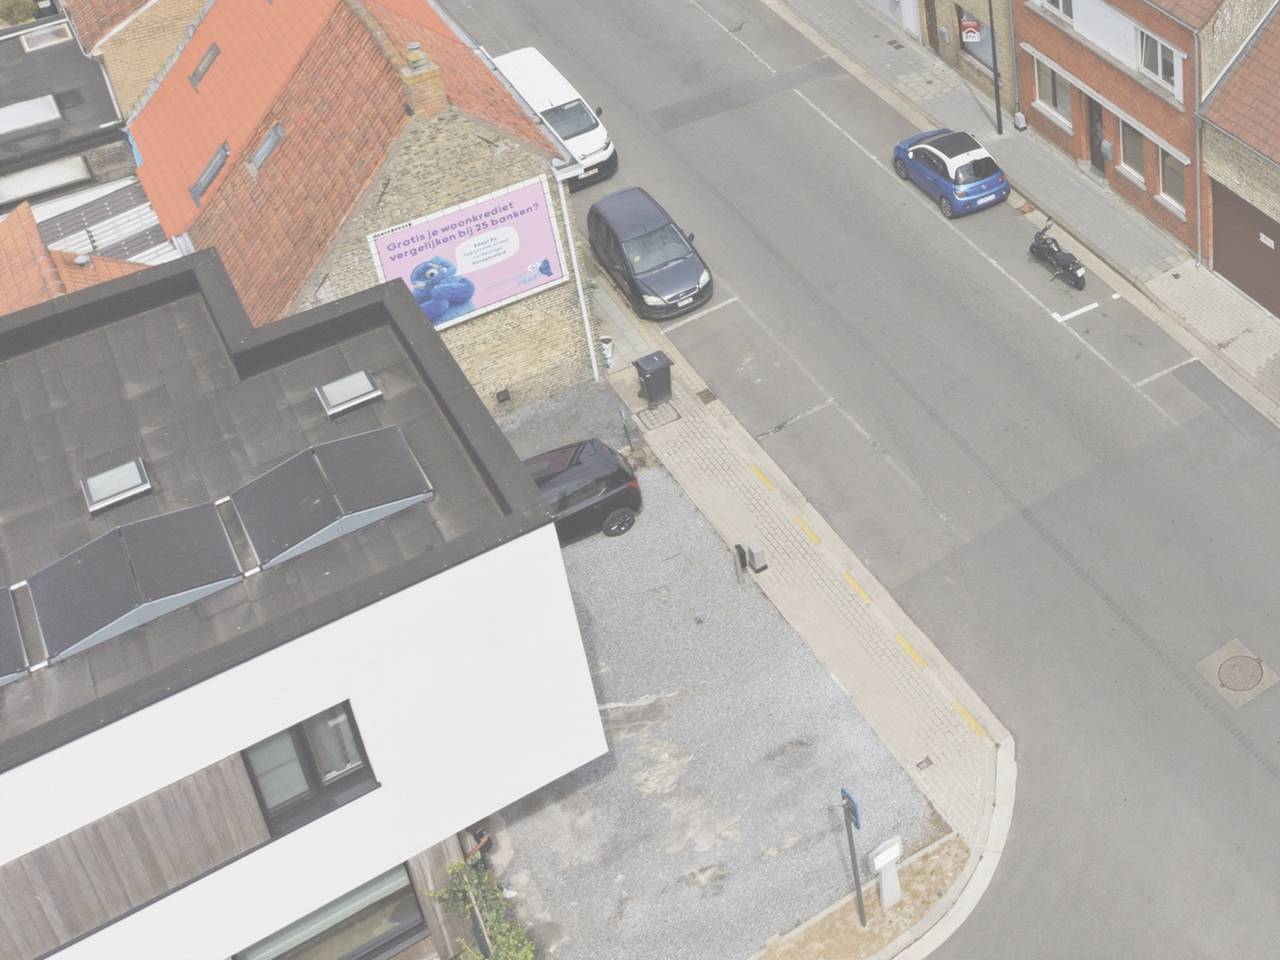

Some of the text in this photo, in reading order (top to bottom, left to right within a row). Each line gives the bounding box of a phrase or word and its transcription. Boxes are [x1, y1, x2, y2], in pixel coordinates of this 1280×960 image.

[386, 234, 426, 251] Gratis
[426, 230, 439, 239] je
[440, 202, 514, 233] woonkrediet
[389, 234, 457, 261] vergelijken
[458, 226, 473, 238] bij
[474, 222, 489, 232] 25
[490, 202, 539, 226] banken?
